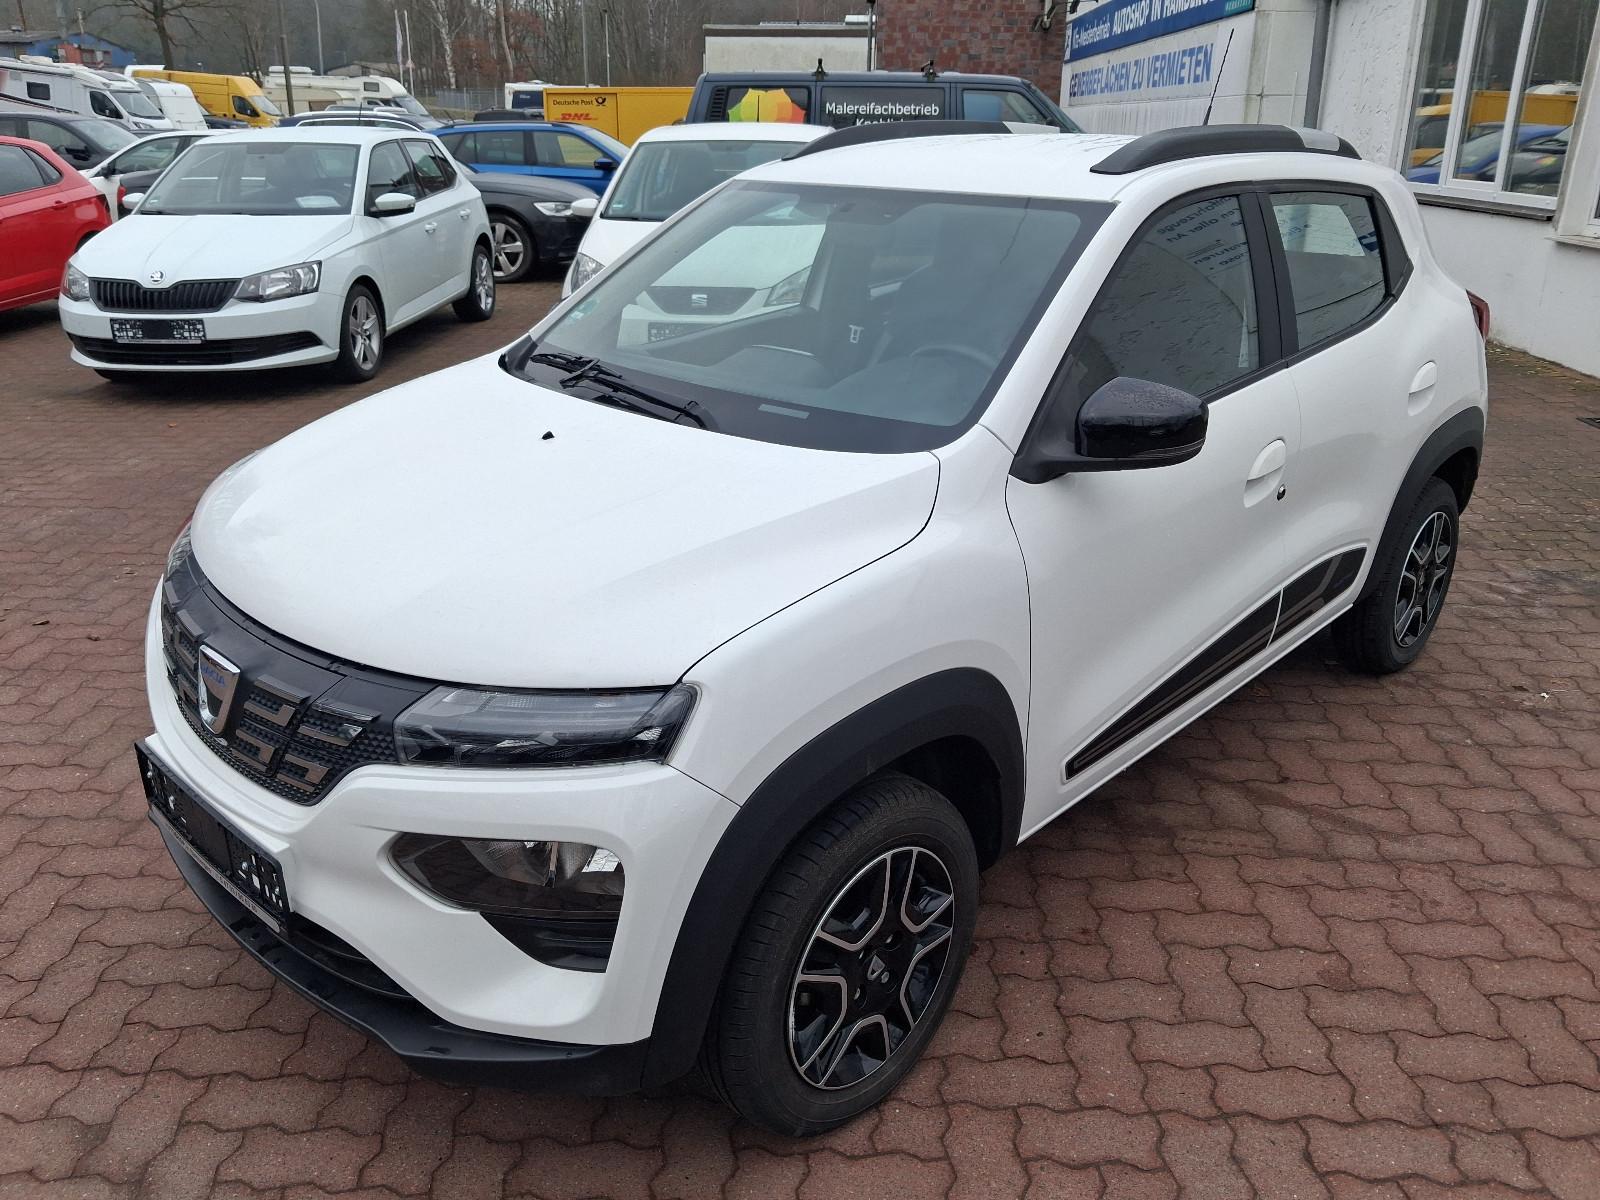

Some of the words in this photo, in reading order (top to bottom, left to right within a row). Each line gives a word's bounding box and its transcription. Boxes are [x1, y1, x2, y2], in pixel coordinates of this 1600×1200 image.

[1112, 0, 1150, 35] AUTOSHOP
[1150, 0, 1162, 22] IN
[1069, 60, 1131, 97] GEWERBEFLÄCHEN
[1131, 58, 1146, 90] ZU
[1146, 43, 1214, 89] VERMIETEN
[560, 112, 593, 120] DHL
[825, 101, 939, 116] Malereifachbetrieb
